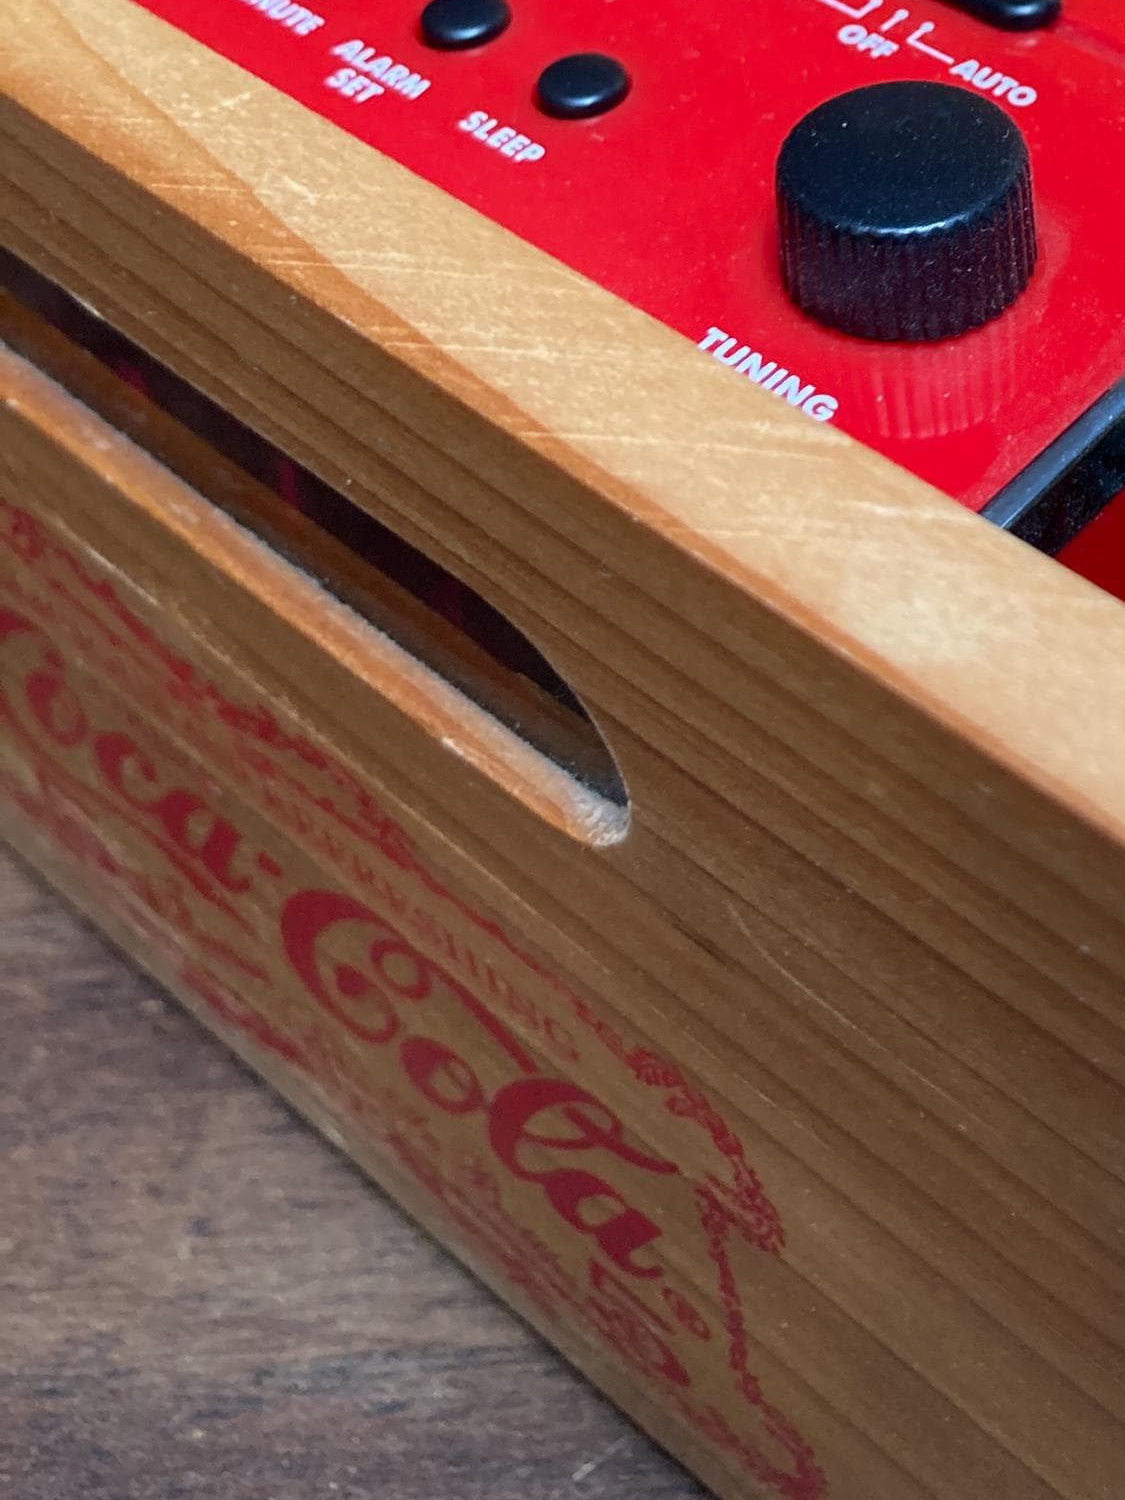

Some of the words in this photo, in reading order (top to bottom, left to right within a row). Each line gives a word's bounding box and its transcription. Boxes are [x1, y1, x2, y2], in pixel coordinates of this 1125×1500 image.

[837, 24, 900, 59] OFF
[324, 68, 385, 103] SET
[330, 39, 432, 101] ALARM
[949, 59, 1038, 107] AUTO
[457, 110, 546, 163] SLEEP
[697, 326, 839, 422] TUNING
